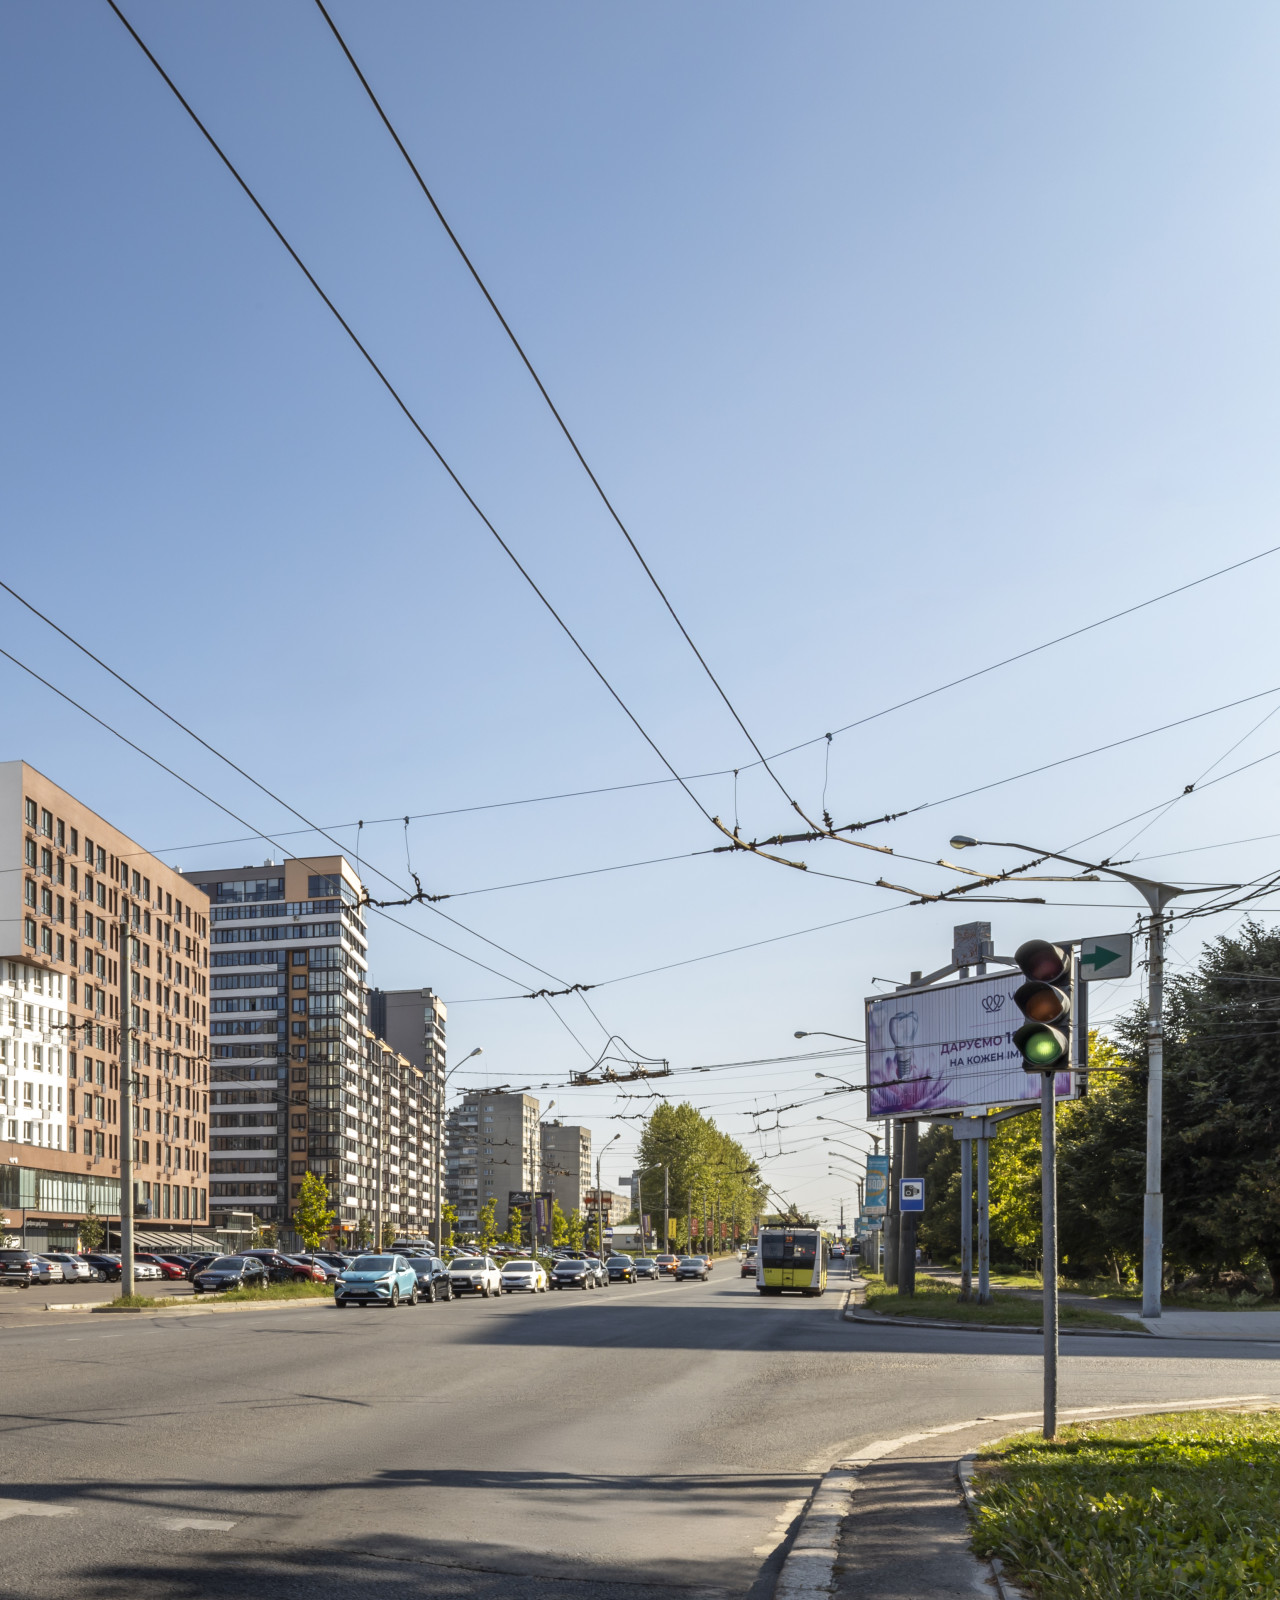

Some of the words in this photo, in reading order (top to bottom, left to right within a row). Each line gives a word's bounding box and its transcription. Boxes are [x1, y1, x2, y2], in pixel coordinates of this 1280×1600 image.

[940, 1035, 1003, 1056] ДАРУЄМО
[949, 1058, 965, 1067] НА
[967, 1051, 1004, 1065] КОЖЕН
